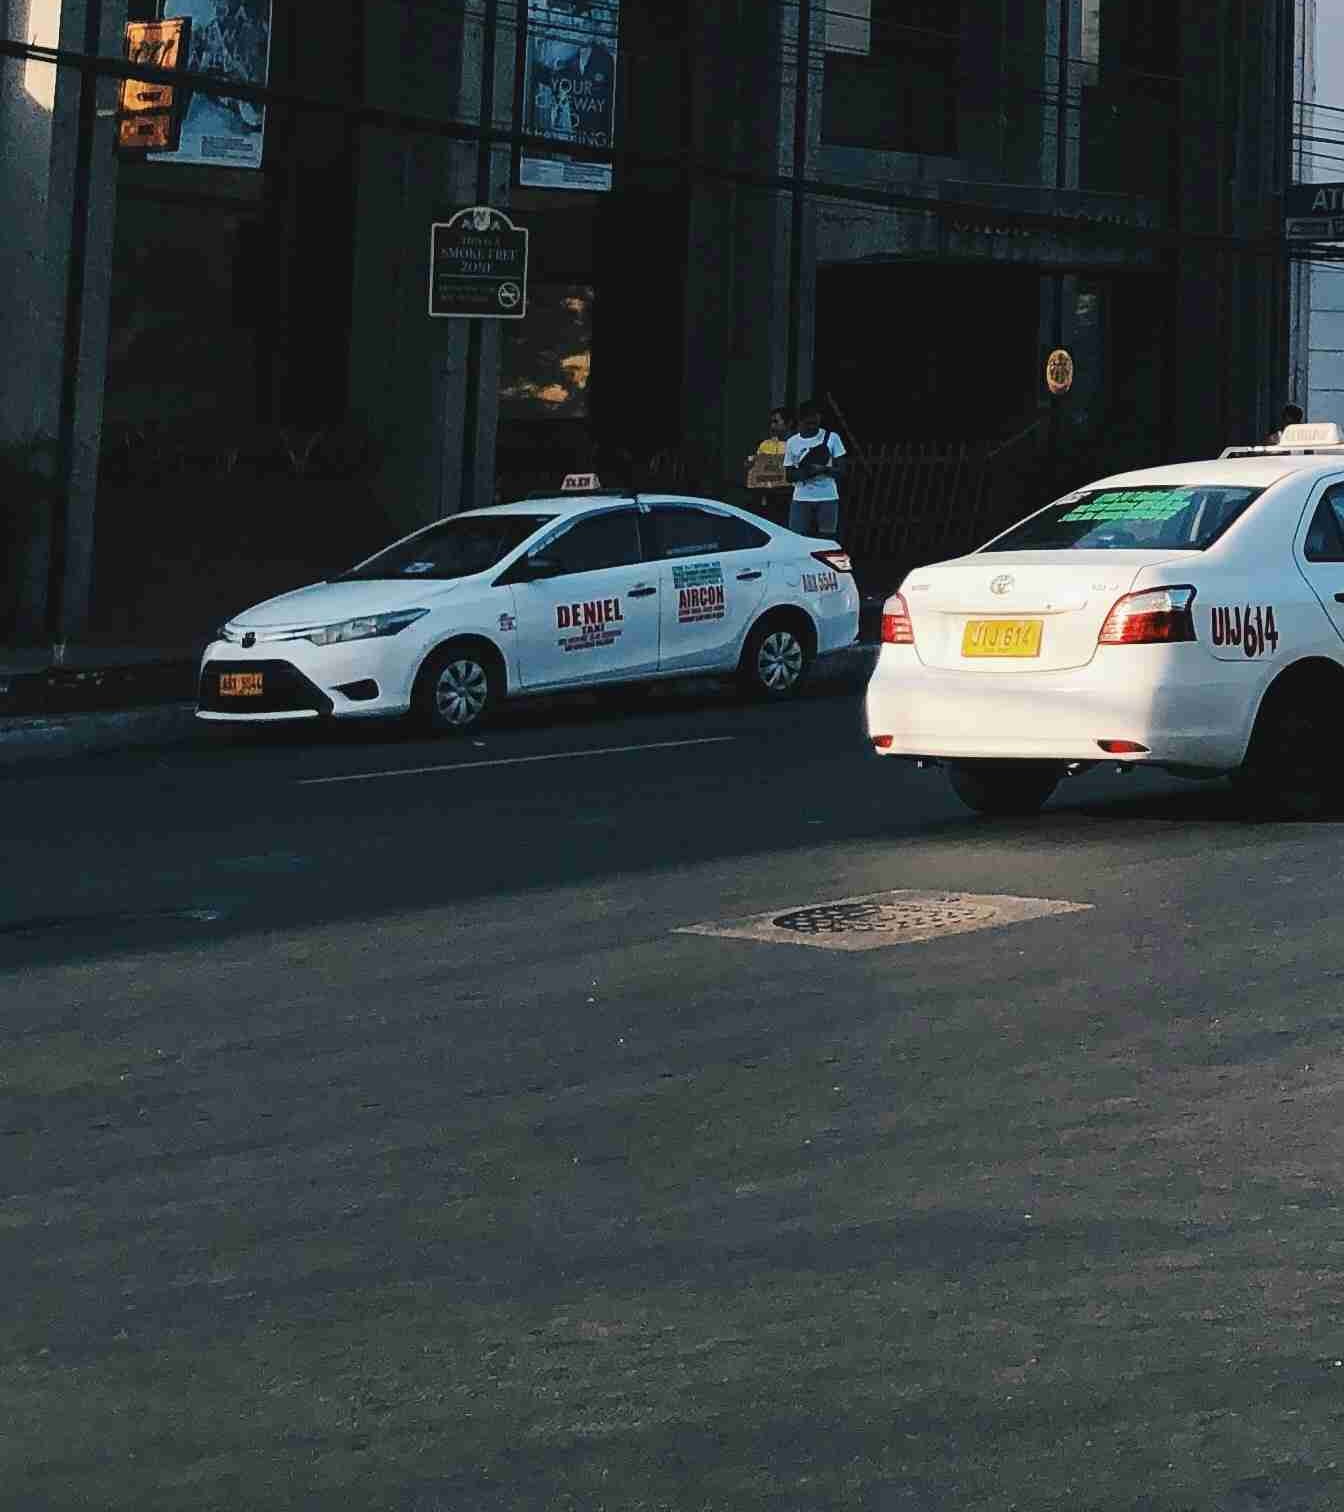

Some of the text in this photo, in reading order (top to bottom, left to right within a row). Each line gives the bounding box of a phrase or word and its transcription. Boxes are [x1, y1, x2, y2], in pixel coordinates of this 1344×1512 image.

[551, 76, 592, 96] YOUR
[678, 585, 724, 609] AIRCON
[556, 598, 624, 628] DENIEL
[582, 623, 605, 635] TAXI
[1002, 625, 1032, 646] 614
